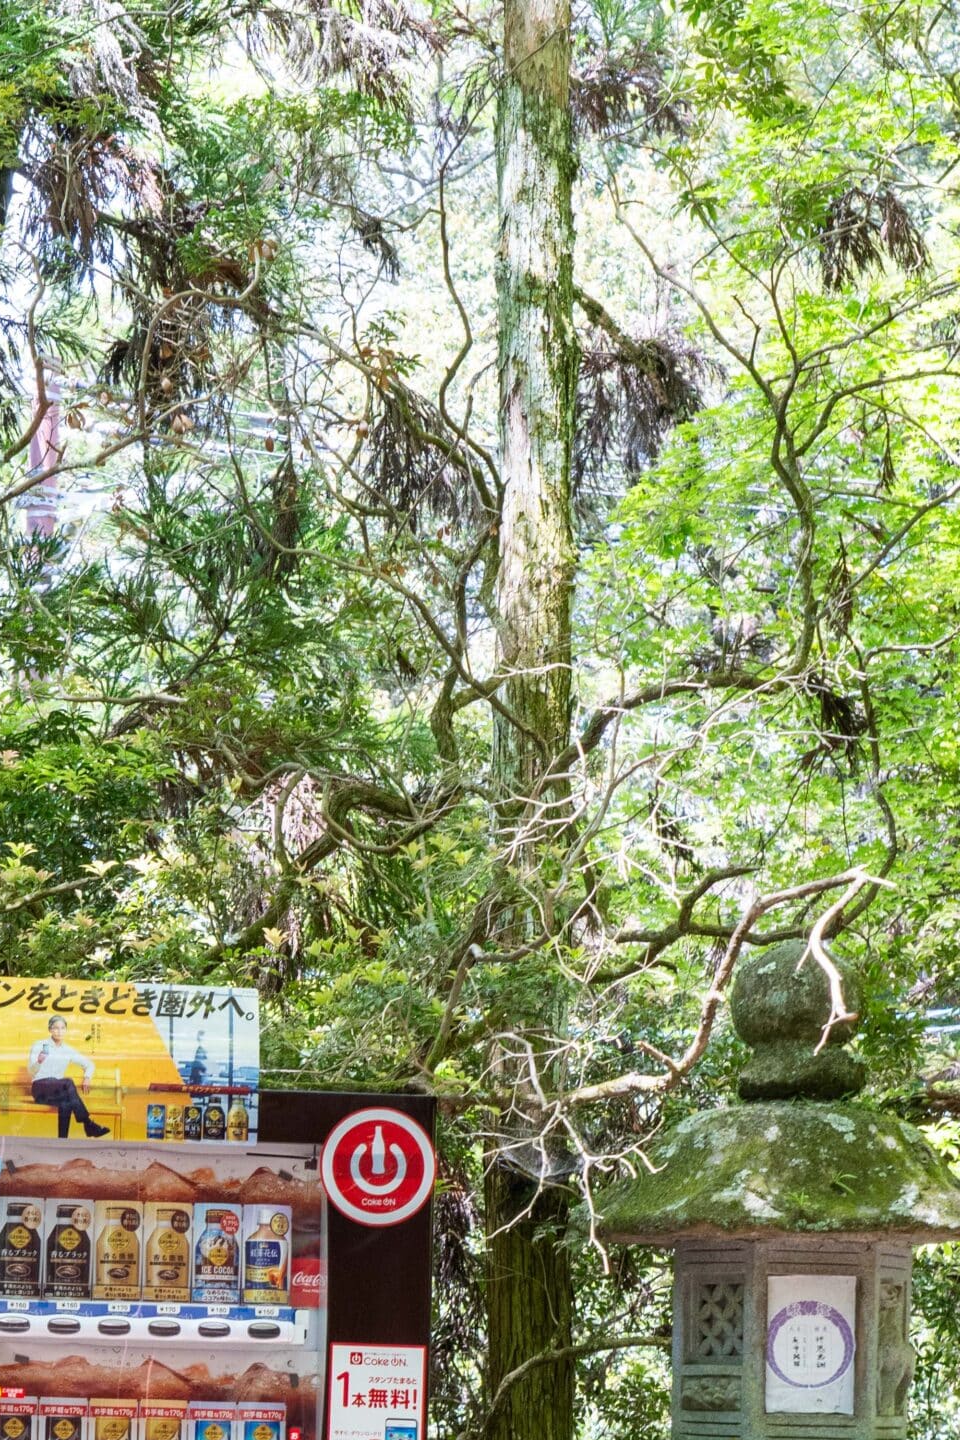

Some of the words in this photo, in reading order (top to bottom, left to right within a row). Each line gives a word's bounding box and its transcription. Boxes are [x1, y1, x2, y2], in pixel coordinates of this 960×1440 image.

[362, 1198, 381, 1206] Coke
[383, 1197, 396, 1206] ON
[201, 1266, 212, 1274] ICE
[213, 1266, 234, 1274] COCOA
[363, 1356, 389, 1366] Coke
[390, 1356, 407, 1367] ON
[368, 1376, 417, 1385] スタンプたまると
[336, 1371, 417, 1410] 1本無料!
